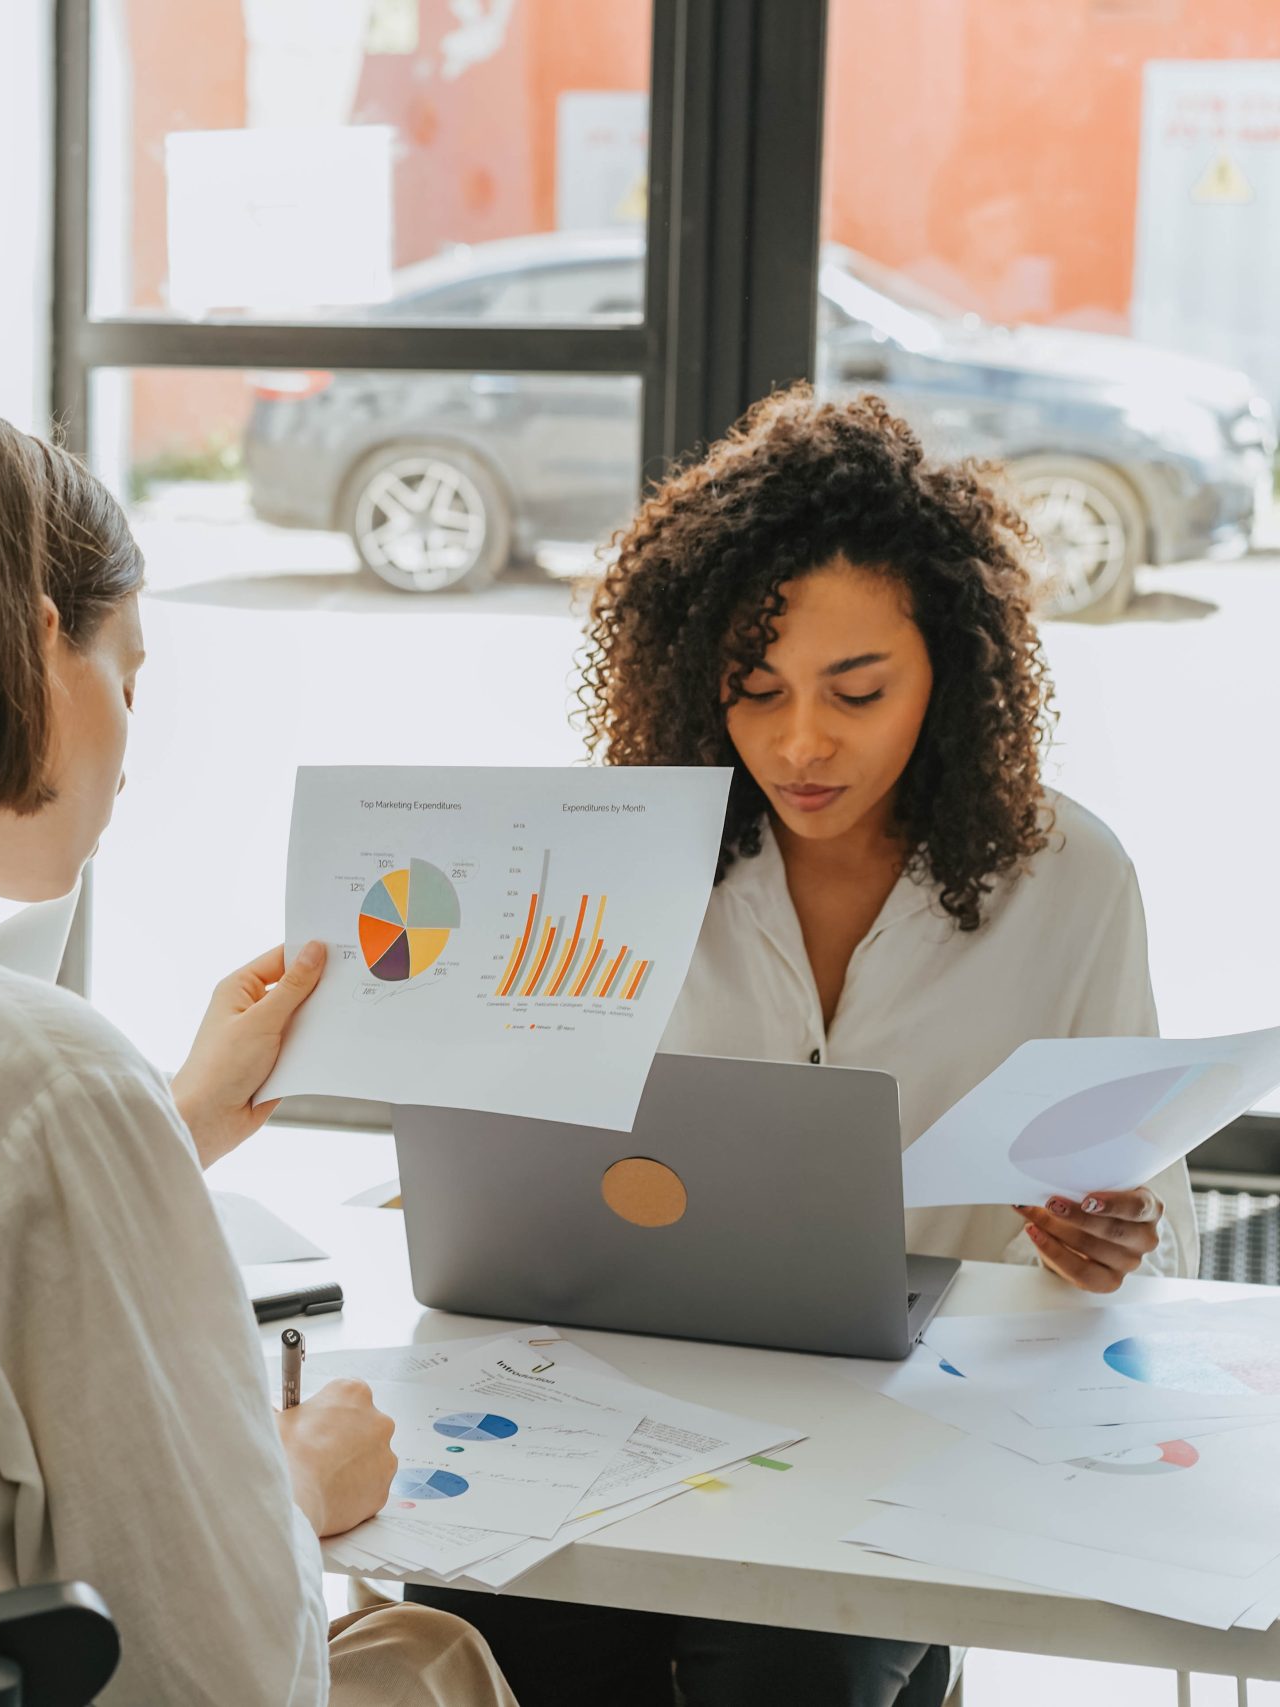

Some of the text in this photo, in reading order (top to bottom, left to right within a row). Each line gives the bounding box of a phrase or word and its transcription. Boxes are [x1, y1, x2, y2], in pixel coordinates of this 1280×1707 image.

[360, 800, 462, 811] Top Marketing Expenditures
[562, 803, 646, 813] Expenditures by Month
[378, 859, 394, 868] 10%
[451, 869, 467, 879] 25%
[350, 883, 365, 892] 12%
[343, 950, 357, 960] 17%
[496, 1360, 556, 1385] Introduction
